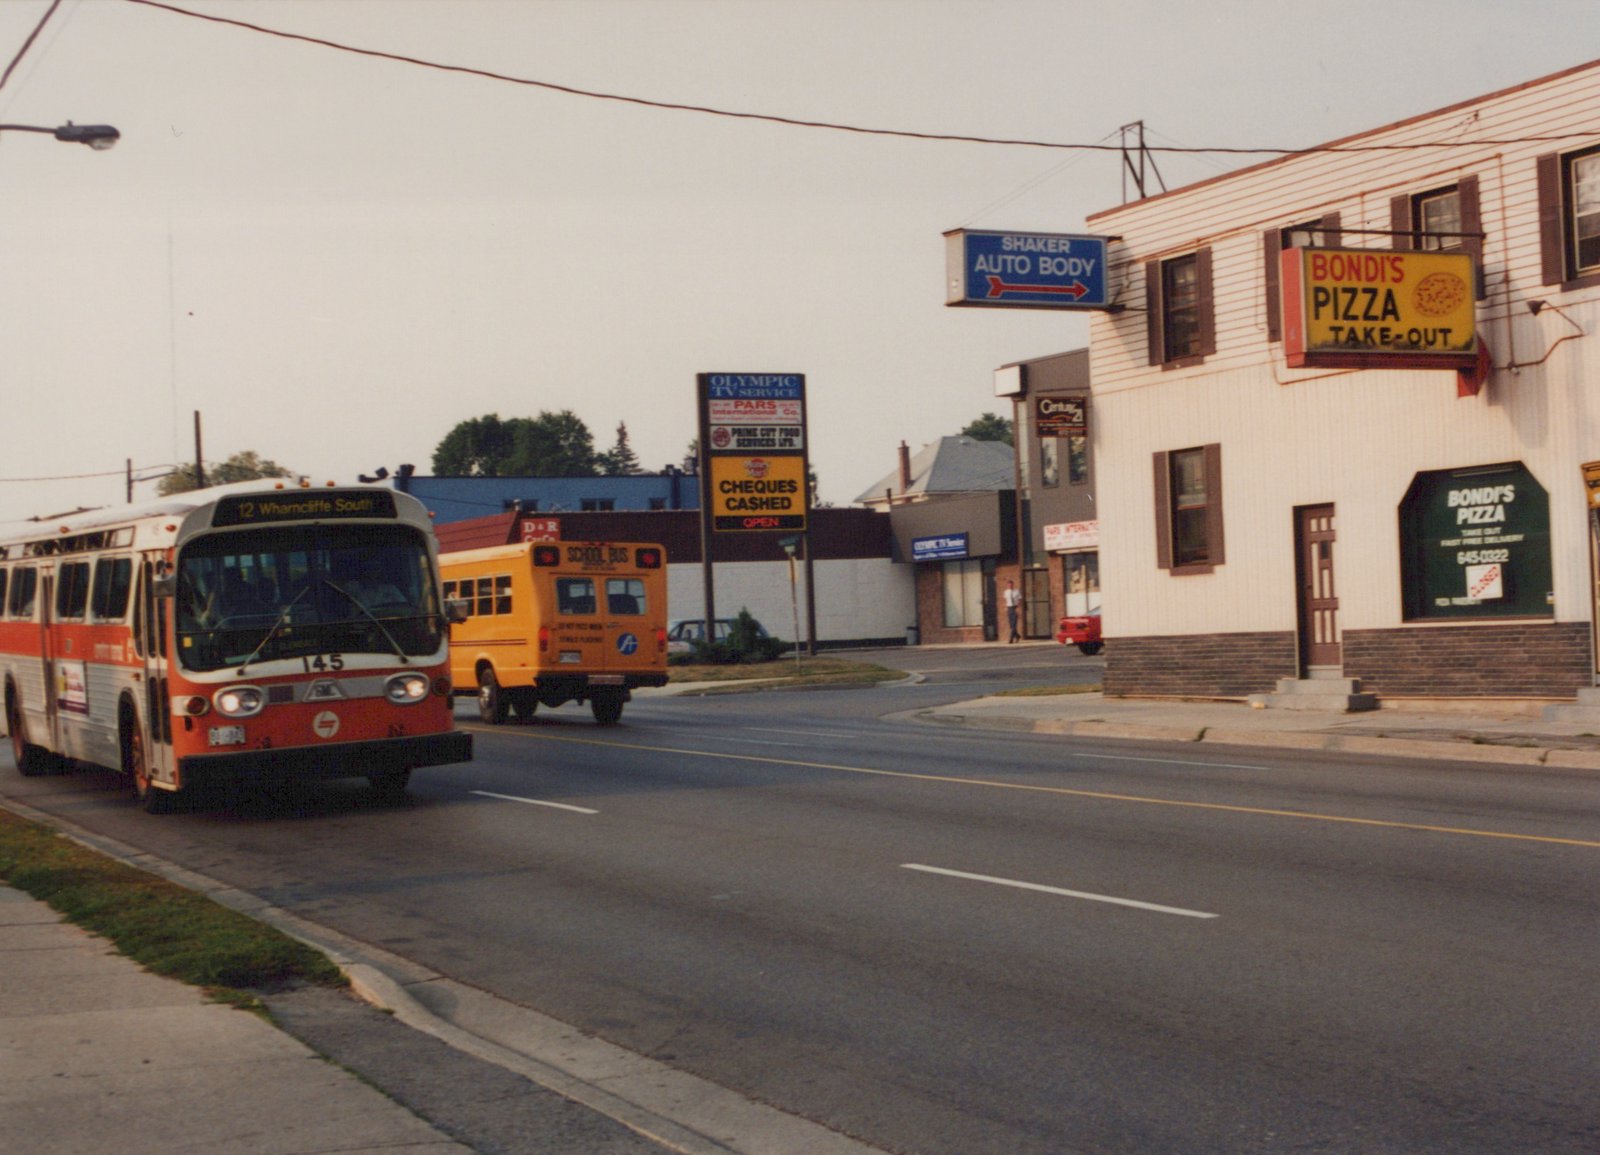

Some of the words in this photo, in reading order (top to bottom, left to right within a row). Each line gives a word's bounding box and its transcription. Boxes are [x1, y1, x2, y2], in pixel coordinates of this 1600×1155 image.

[1002, 237, 1071, 253] SHAKER
[974, 254, 1031, 274] AUTO
[1039, 257, 1095, 277] BODY
[1312, 254, 1405, 283] BONDI'S
[1313, 286, 1401, 321] PIZZA
[1329, 326, 1453, 346] TAKE-OUT
[711, 375, 798, 387] OLYMPIC
[712, 386, 736, 397] TV
[738, 388, 798, 397] SERVICE
[734, 400, 777, 409] PARS
[719, 480, 797, 494] CHEQUES
[1448, 484, 1515, 507] BONDI'S
[239, 503, 254, 517] 12
[259, 500, 331, 515] Wharncliffe
[336, 498, 373, 511] South
[725, 497, 792, 510] CASHED
[743, 517, 780, 528] OPEN
[1456, 504, 1506, 525] PIZZA
[523, 522, 536, 533] D
[547, 521, 559, 532] R
[567, 547, 606, 564] SCHOOL
[609, 548, 629, 563] BUS
[303, 654, 344, 672] 145
